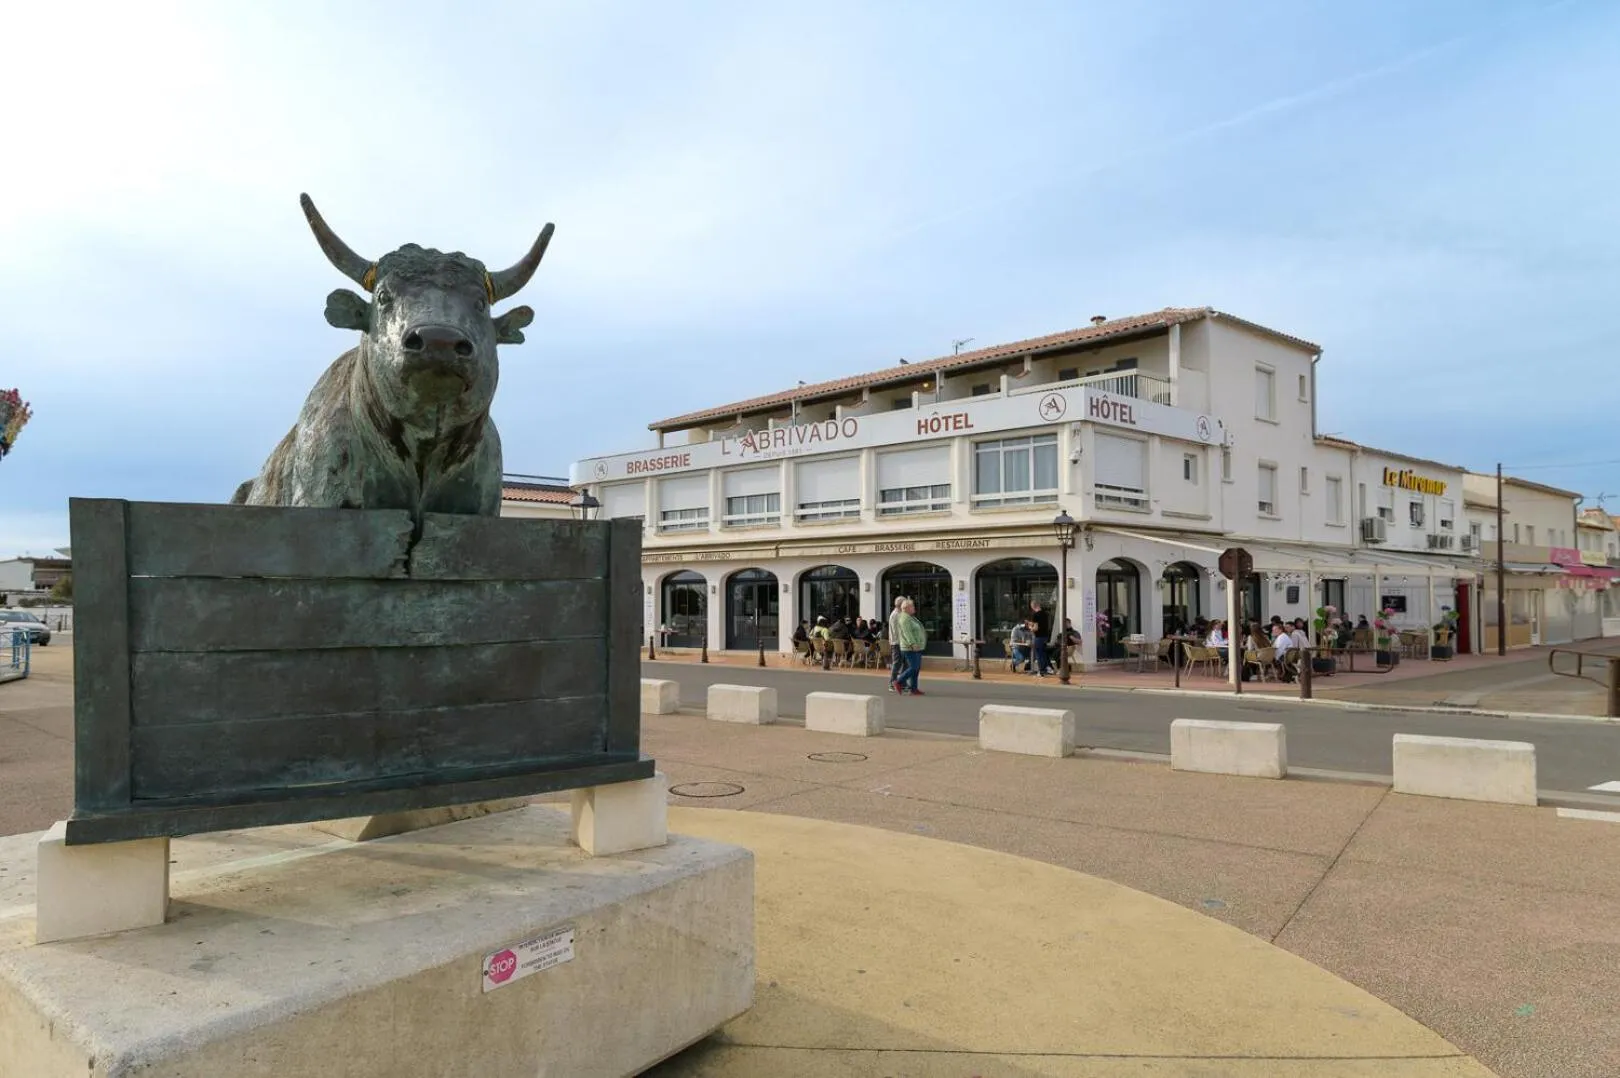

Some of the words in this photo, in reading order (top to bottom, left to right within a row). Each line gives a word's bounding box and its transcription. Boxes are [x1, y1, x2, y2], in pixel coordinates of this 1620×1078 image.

[1090, 395, 1136, 424] HÔTEL
[917, 411, 974, 435] HÔTEL
[626, 453, 690, 474] BRASSERIE
[935, 539, 991, 549] RESTAURANT
[490, 957, 515, 976] STOP
